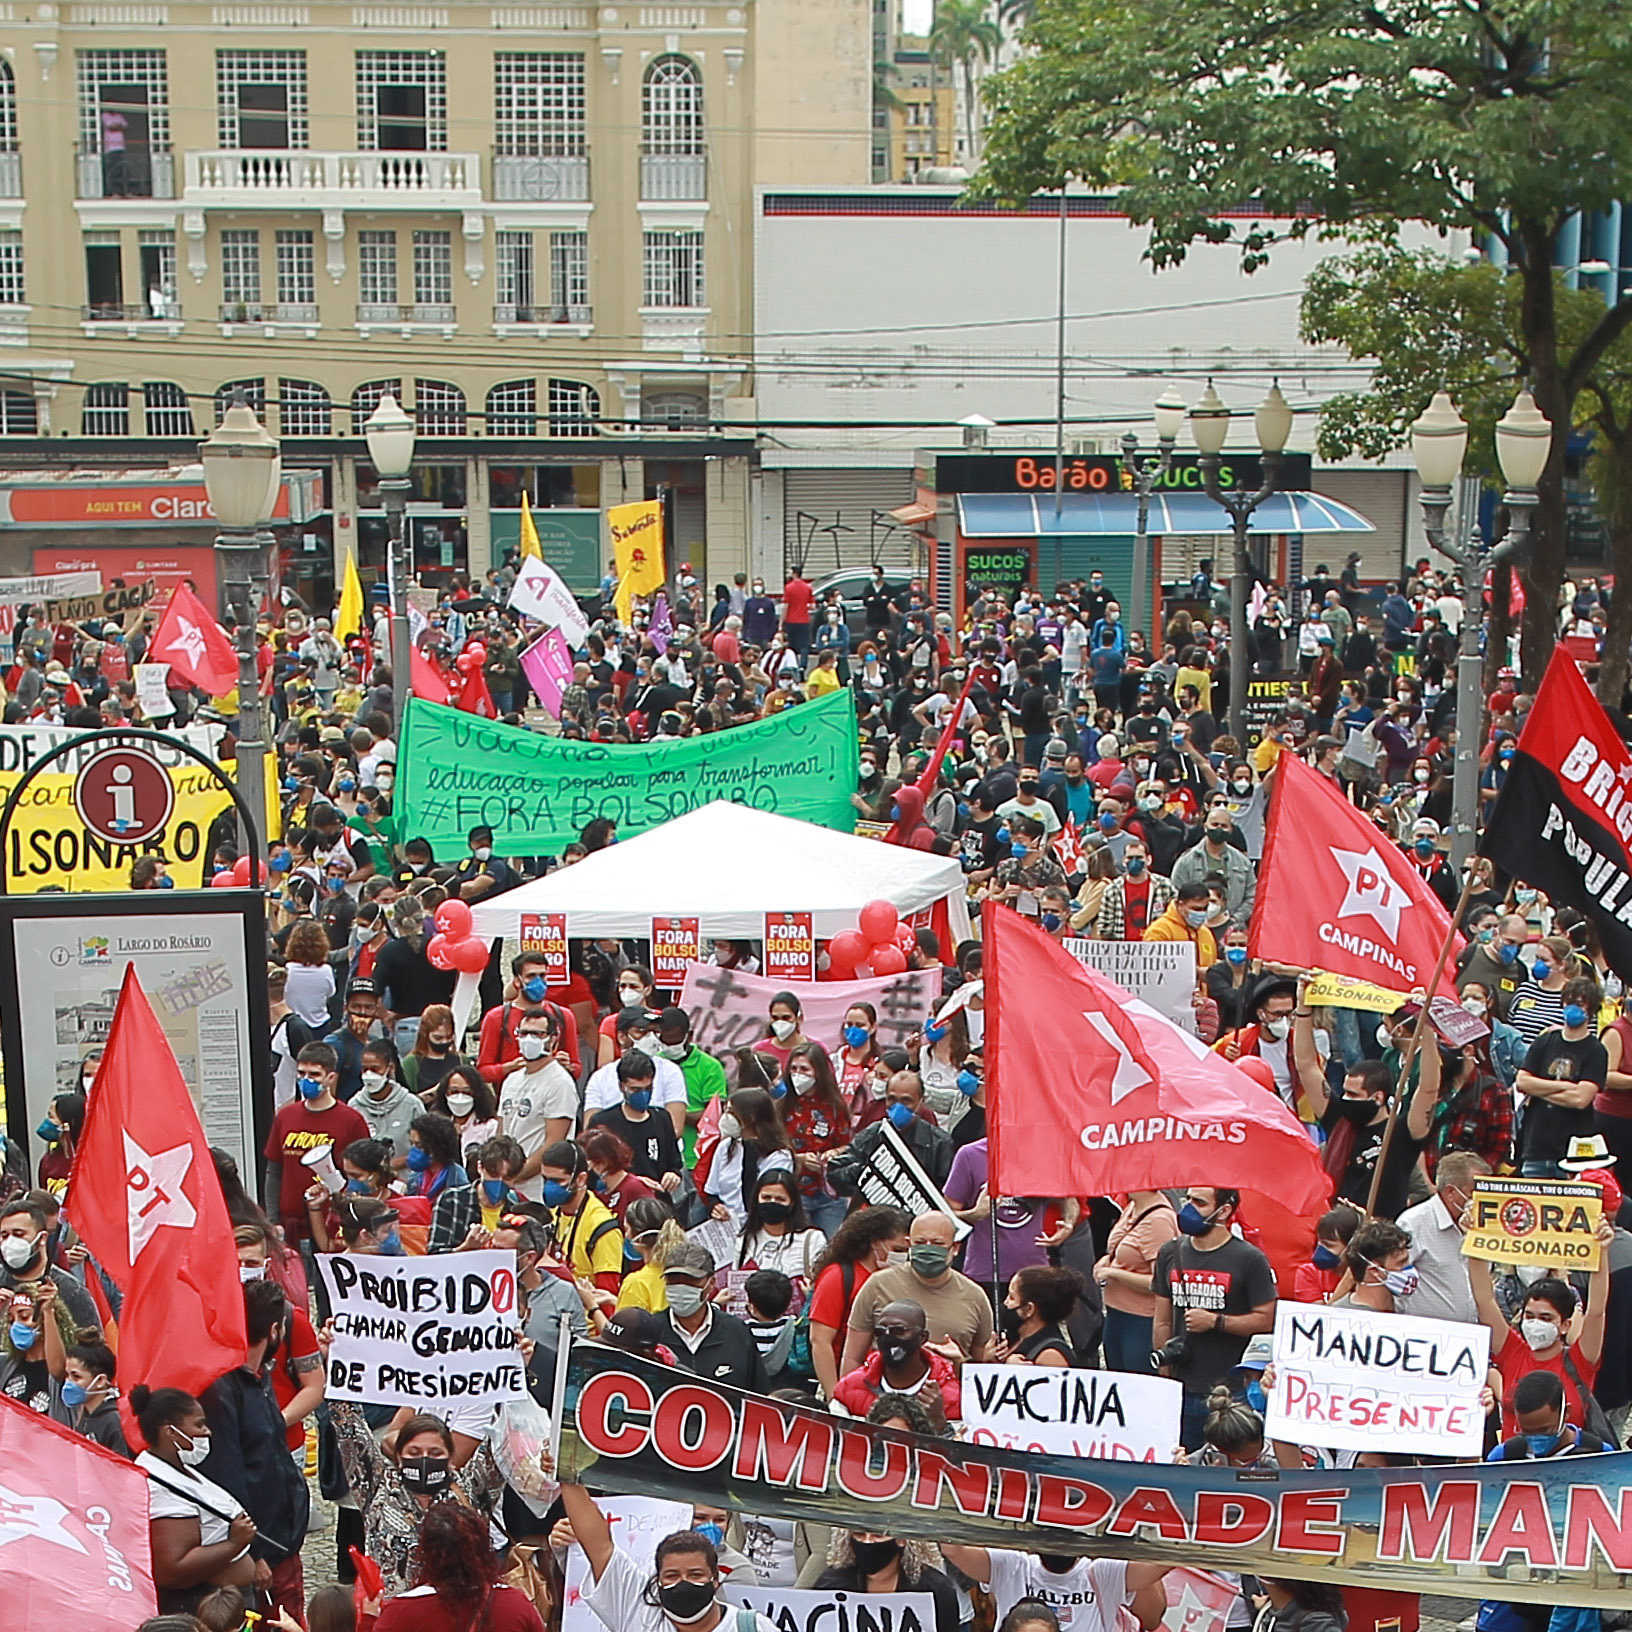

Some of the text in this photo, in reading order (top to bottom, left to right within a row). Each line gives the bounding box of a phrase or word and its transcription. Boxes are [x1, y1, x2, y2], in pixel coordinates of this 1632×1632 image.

[1015, 455, 1109, 488] Barão
[116, 501, 142, 513] TEM
[968, 556, 1025, 568] SUCOS
[971, 570, 1022, 582] naturais
[429, 768, 546, 796] educação
[1355, 863, 1394, 906] PT
[523, 925, 562, 940] FORA
[656, 930, 694, 944] FORA
[769, 925, 808, 938] FORA
[118, 934, 212, 952] LARGO ROSÁRIO
[521, 940, 566, 953] BOLSO
[654, 944, 697, 957] BOLSO
[766, 938, 811, 952] BOLSO
[1319, 922, 1418, 982] CAMPINAS
[770, 951, 809, 966] NARO
[1310, 983, 1395, 1005] BOLSONARO
[1078, 1118, 1247, 1152] CAMPINAS
[124, 1168, 173, 1223] PT
[1476, 1181, 1489, 1191] NÃO
[1489, 1182, 1503, 1192] TIRE
[1503, 1183, 1509, 1192] A
[1542, 1185, 1556, 1194] TIRE
[1556, 1186, 1563, 1194] O
[1563, 1186, 1597, 1197] GENOCIDA
[1473, 1236, 1591, 1259] BOLSONARO
[330, 1312, 408, 1345] CHAMAR
[1289, 1314, 1478, 1382] MANDELA
[330, 1361, 524, 1396] DE PRESIDENTE
[973, 1372, 1127, 1430] VACINA
[1282, 1376, 1471, 1436] PRESENTE
[577, 1370, 1351, 1556] COMUNIDADE
